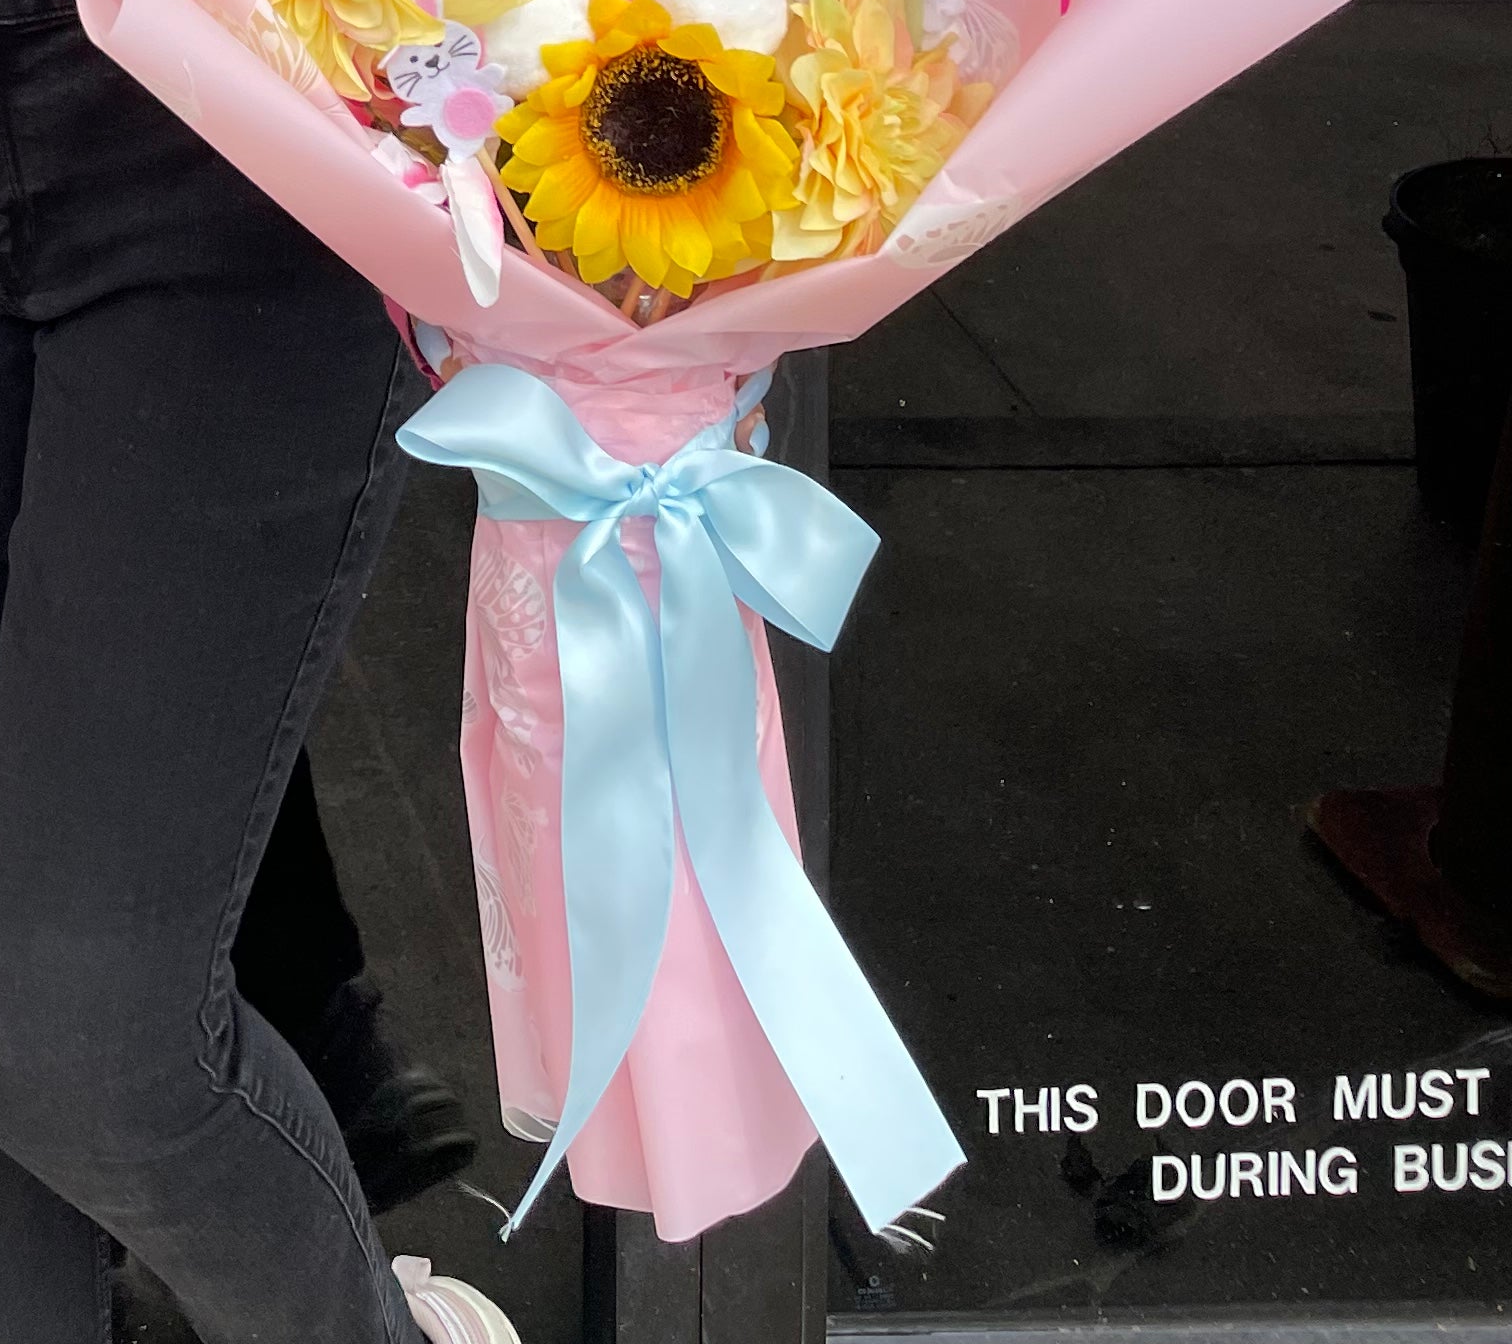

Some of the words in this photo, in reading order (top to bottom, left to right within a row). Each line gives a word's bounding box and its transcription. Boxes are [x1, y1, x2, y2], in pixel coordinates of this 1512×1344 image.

[976, 1083, 1099, 1135] THIS
[1136, 1077, 1297, 1130] DOOR
[1333, 1067, 1491, 1121] MUST
[1151, 1146, 1358, 1203] DURING
